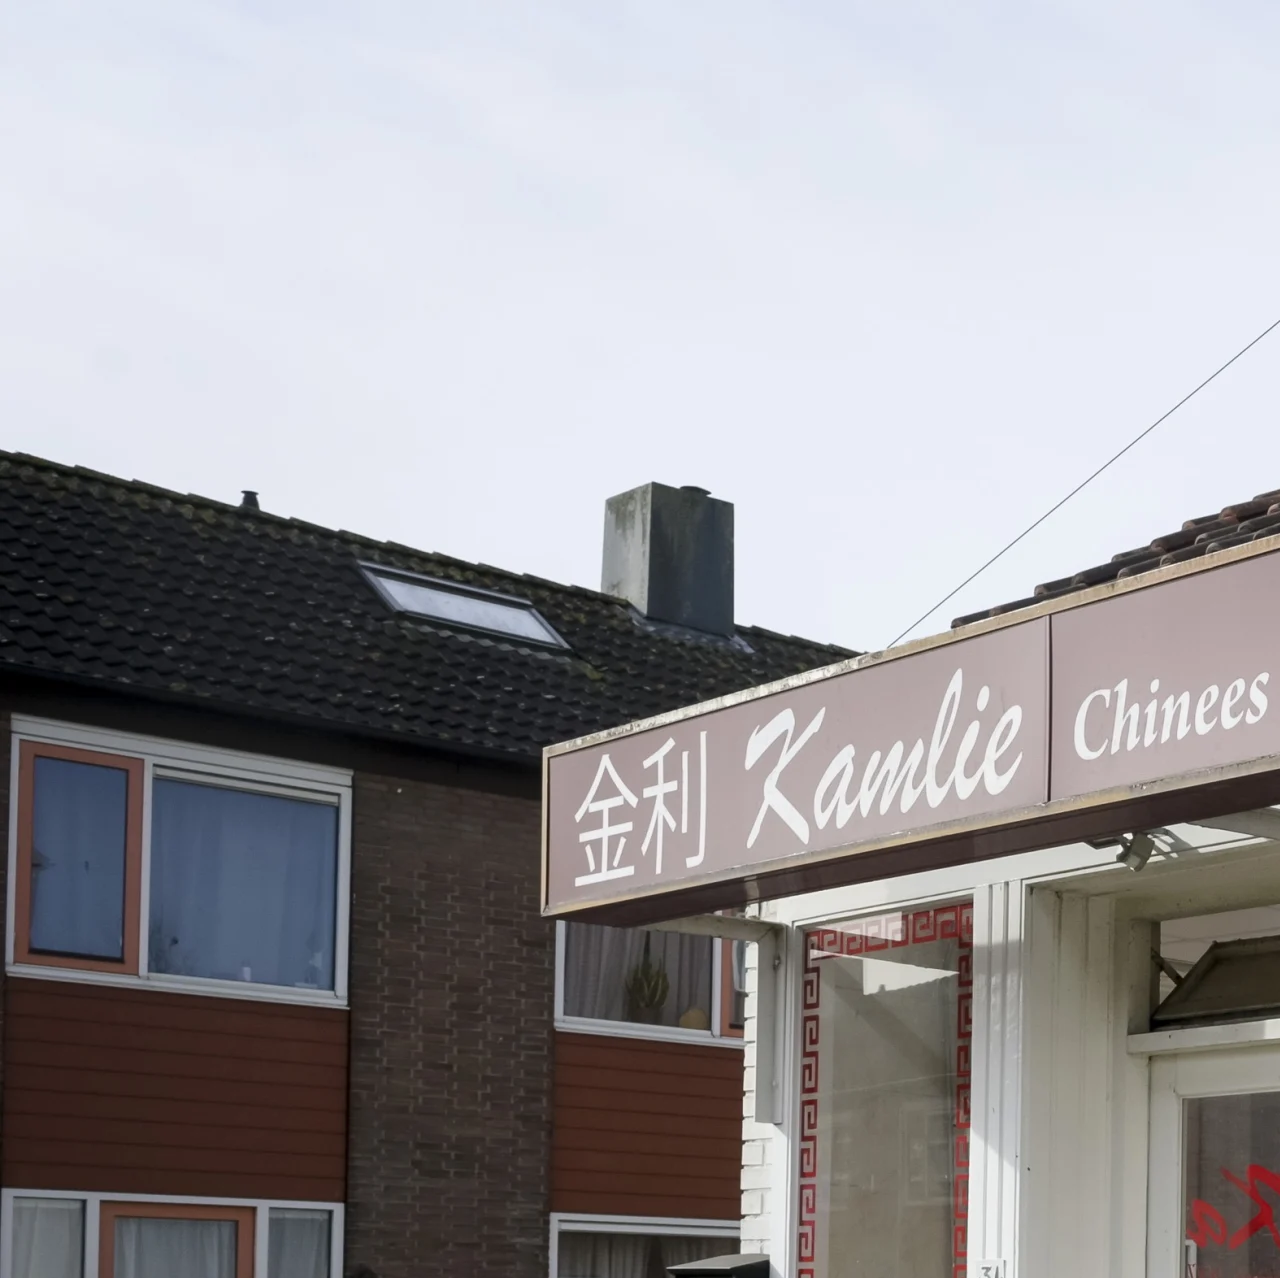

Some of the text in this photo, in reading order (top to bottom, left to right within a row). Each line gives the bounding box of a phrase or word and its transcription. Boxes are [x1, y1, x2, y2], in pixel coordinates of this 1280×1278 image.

[744, 668, 1023, 849] Kamlie
[1073, 671, 1269, 761] Chinees
[575, 731, 708, 888] 金利
